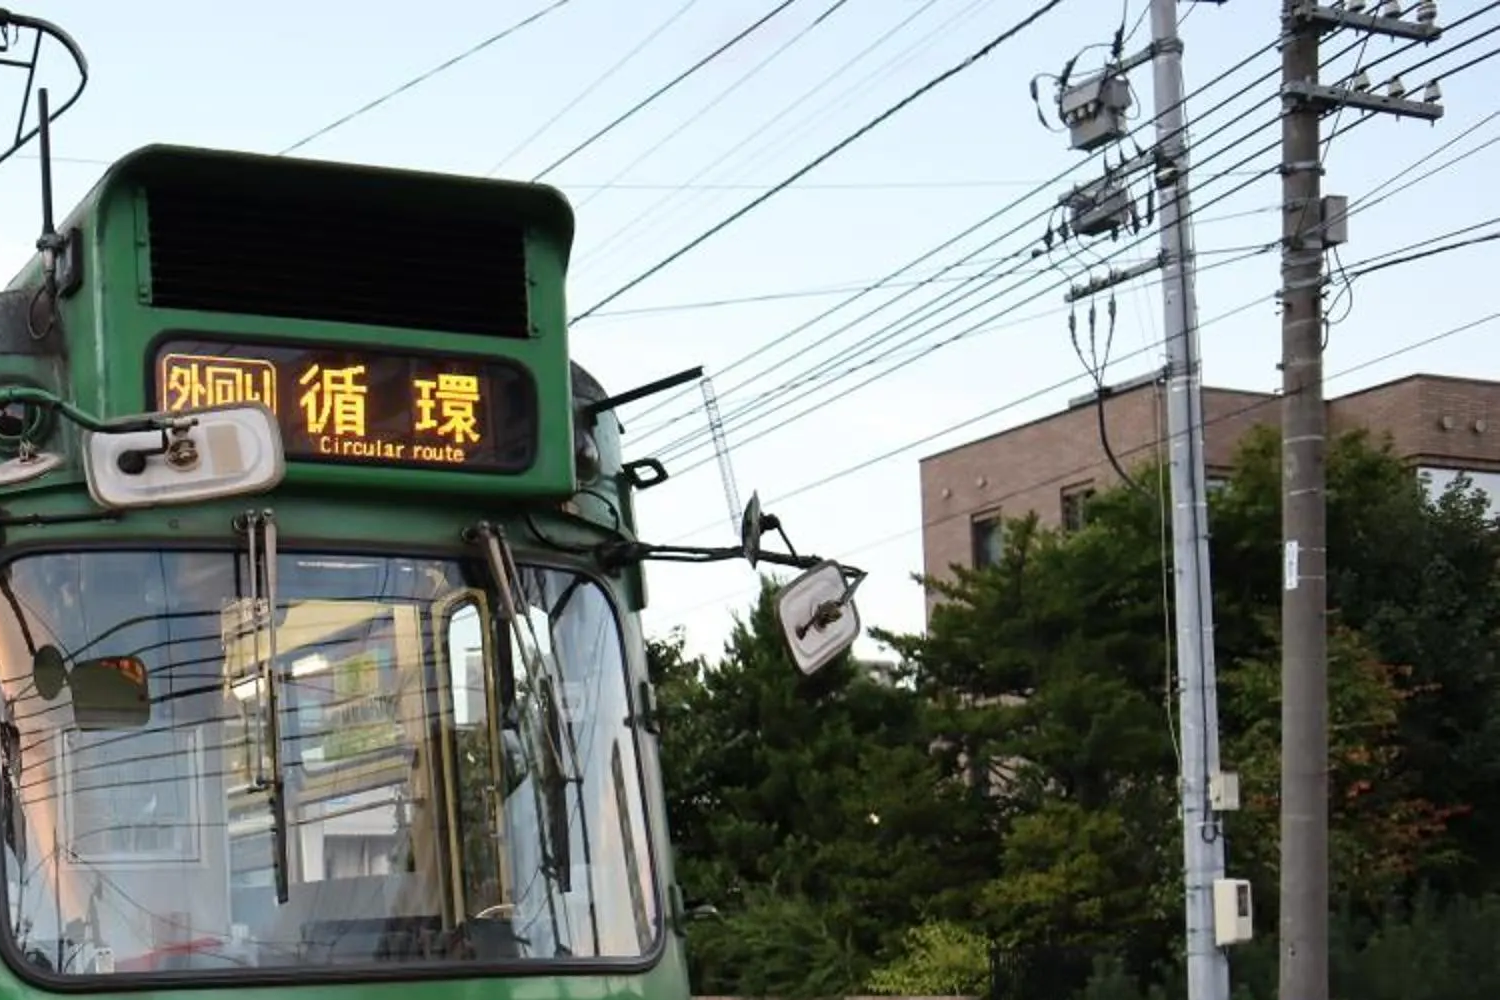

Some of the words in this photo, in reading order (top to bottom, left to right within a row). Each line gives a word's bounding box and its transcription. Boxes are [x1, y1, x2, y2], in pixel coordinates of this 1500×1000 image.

[169, 363, 270, 411] 外回り
[320, 436, 405, 459] Circular
[413, 445, 465, 463] route
